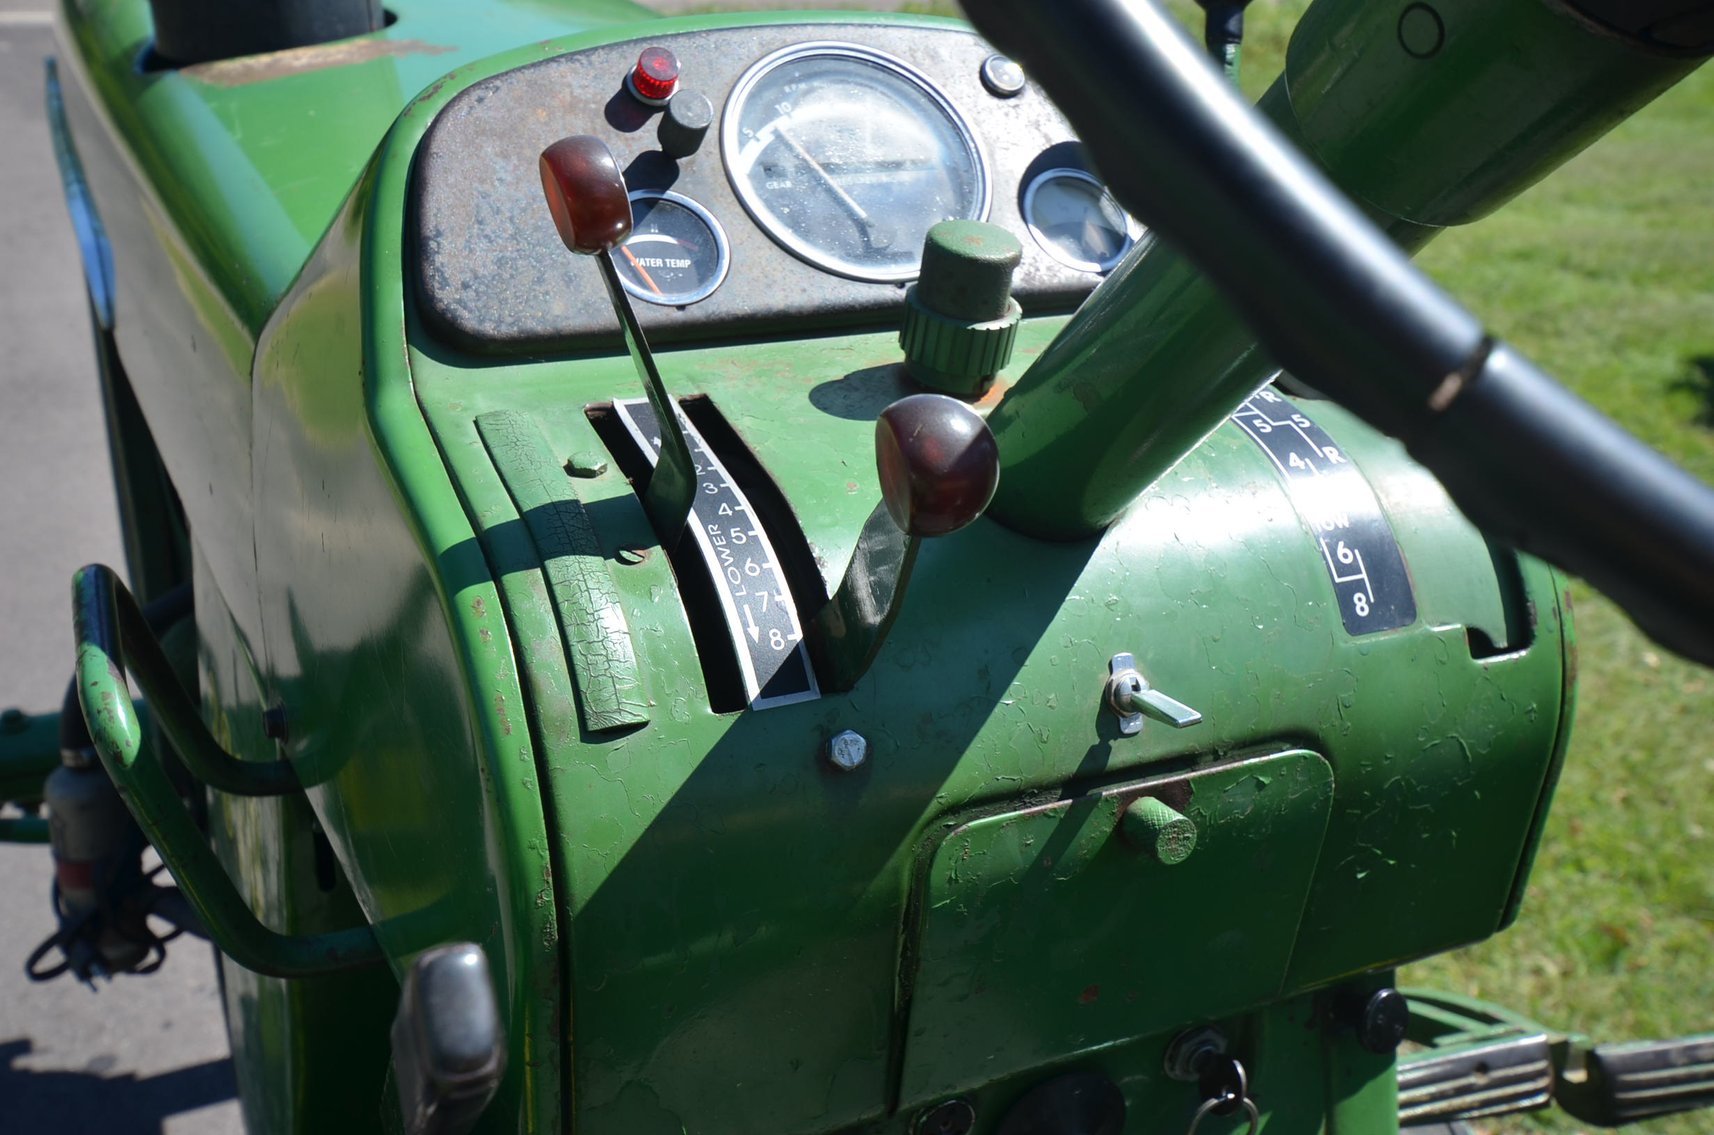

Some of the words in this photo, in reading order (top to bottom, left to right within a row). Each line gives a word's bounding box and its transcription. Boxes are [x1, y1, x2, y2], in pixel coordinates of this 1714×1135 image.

[774, 101, 792, 115] 10
[742, 127, 754, 138] 5
[765, 180, 793, 190] GEAR
[664, 258, 692, 269] TEMP
[1252, 419, 1273, 433] 5
[1290, 414, 1311, 428] 5
[1289, 452, 1306, 470] 4
[1321, 446, 1347, 464] R
[694, 464, 706, 475] 2
[702, 482, 719, 495] 3
[718, 502, 733, 517] 4
[730, 527, 747, 545] 5
[708, 523, 747, 597] LOWER
[1336, 540, 1354, 564] 6
[744, 557, 761, 577] 6
[754, 591, 769, 613] 7
[1352, 592, 1370, 617] 8
[768, 628, 785, 651] 8
